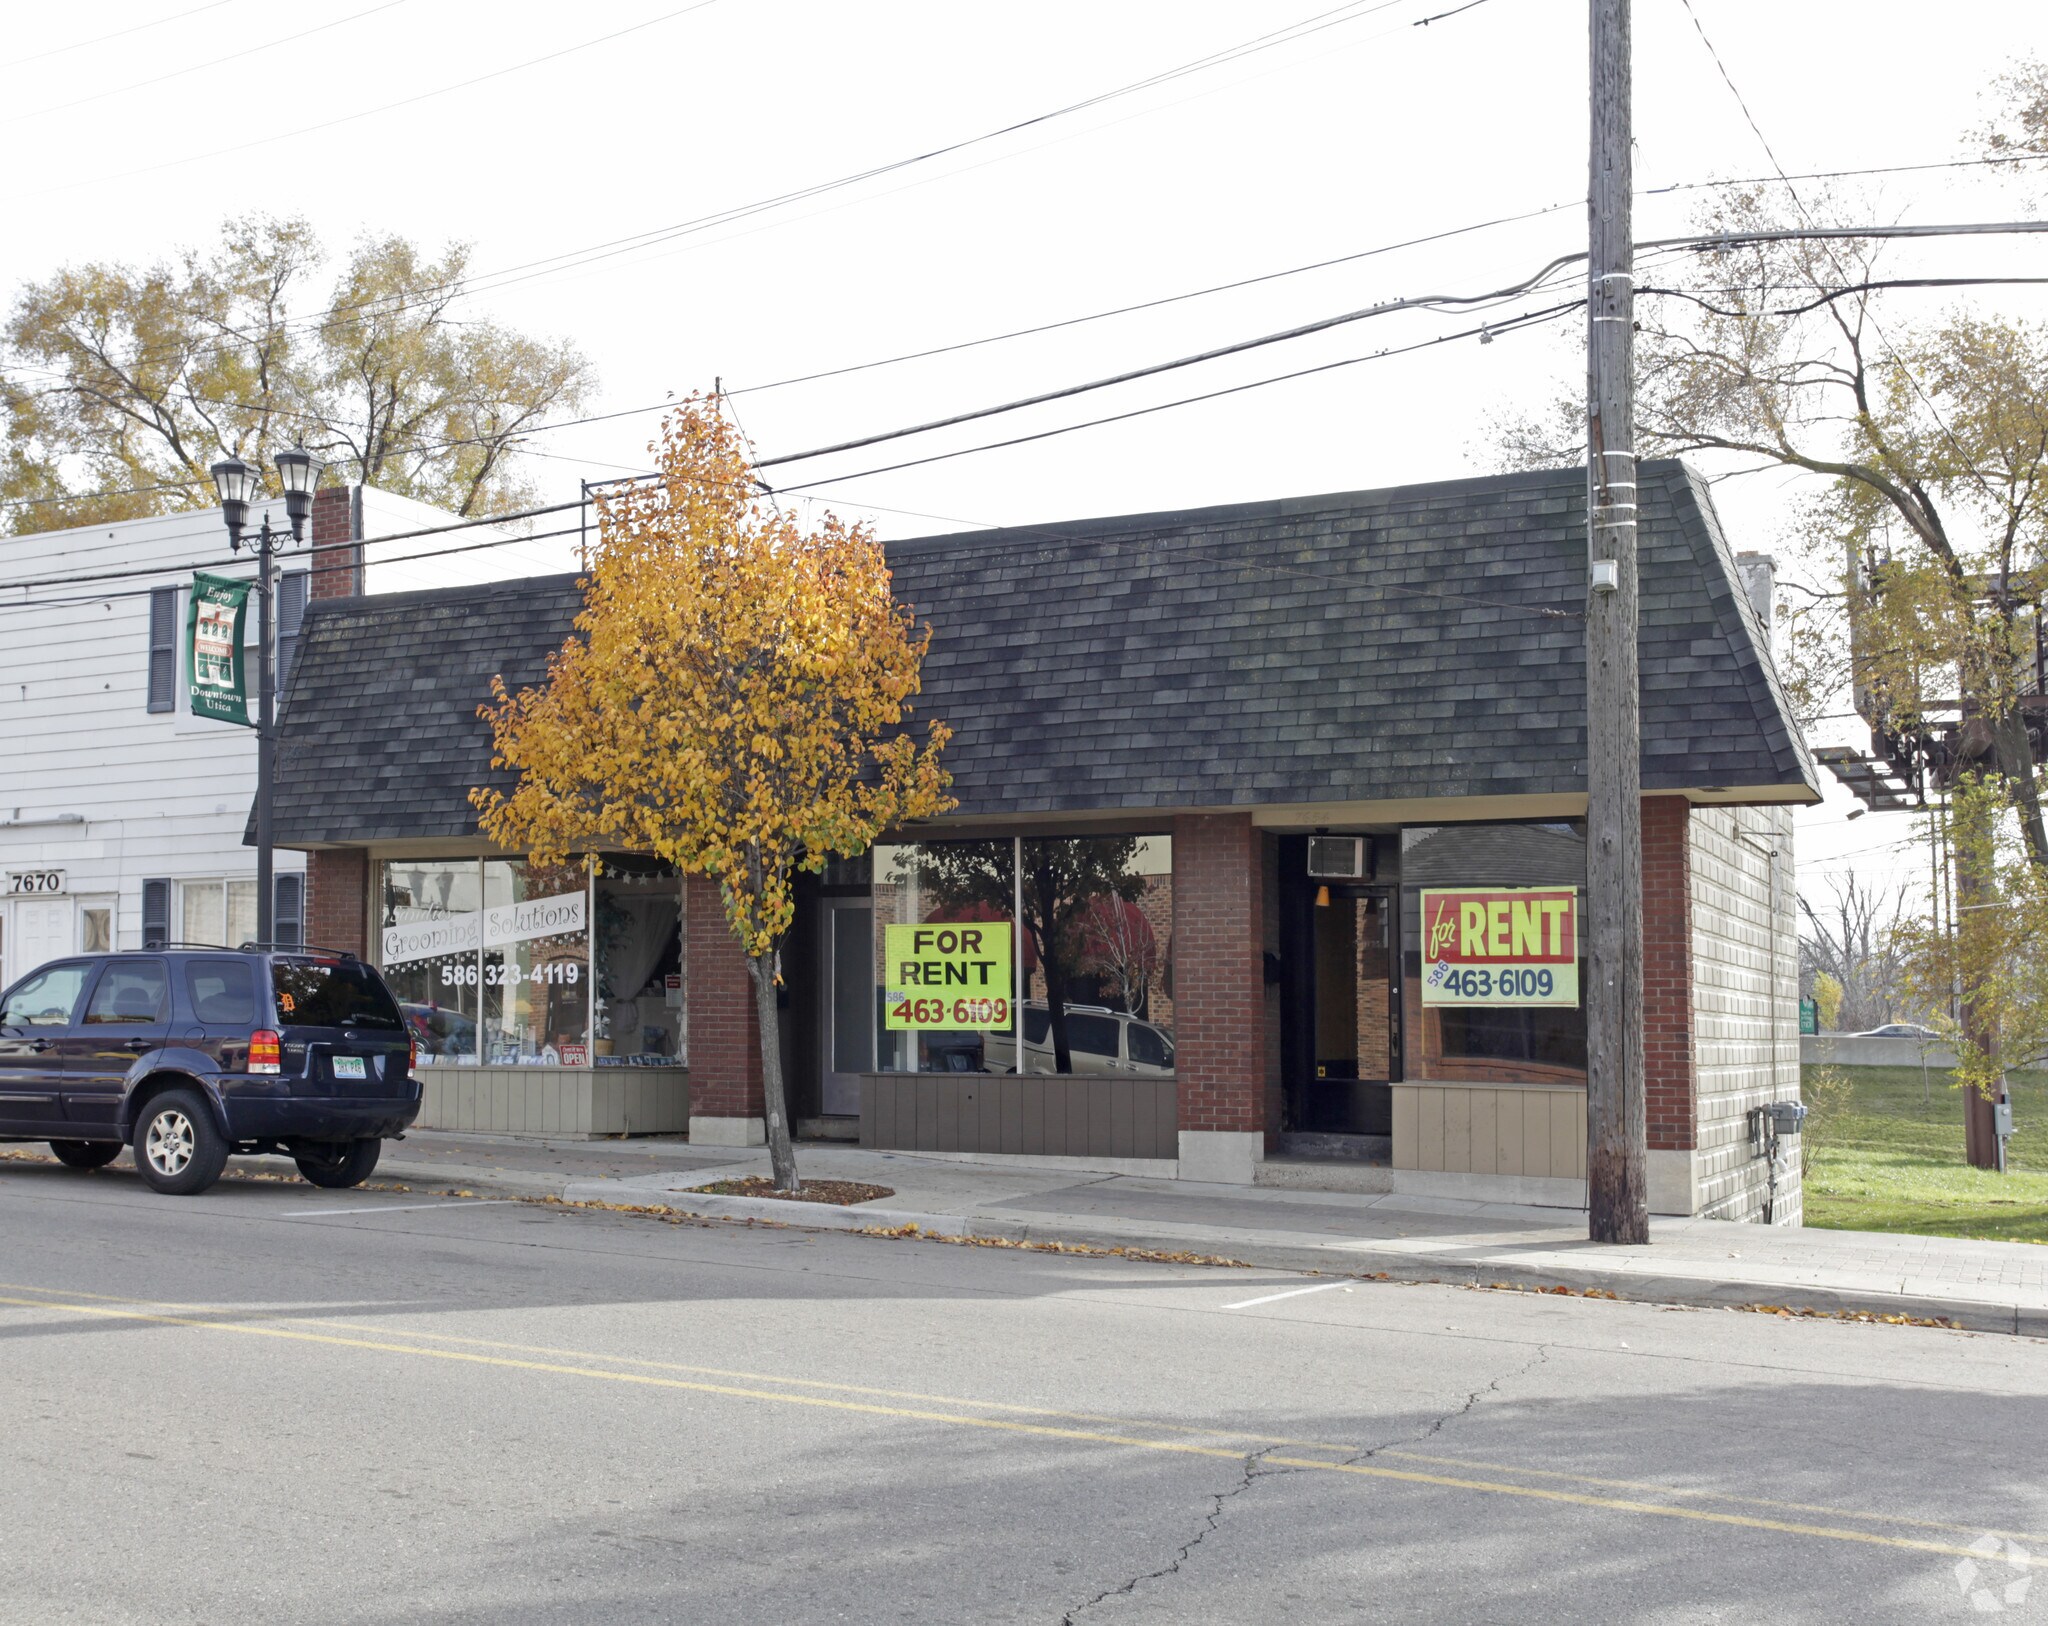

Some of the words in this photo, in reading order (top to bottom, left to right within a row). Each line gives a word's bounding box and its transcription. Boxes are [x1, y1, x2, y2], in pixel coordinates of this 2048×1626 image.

[207, 586, 233, 602] Enjoy
[200, 643, 227, 655] WELCOME
[191, 686, 241, 703] Downtown
[206, 699, 231, 712] Utica
[12, 874, 59, 892] 7670
[385, 918, 479, 961] Grooming
[490, 903, 579, 937] Solutions
[1429, 900, 1456, 959] for
[1460, 900, 1569, 957] RENT
[914, 930, 983, 954] FOR
[441, 965, 477, 985] 586
[485, 963, 579, 985] 323-4119
[900, 961, 996, 985] RENT
[1427, 961, 1449, 987] 586
[1443, 969, 1553, 997] 463-6109
[887, 992, 905, 1002] 586
[892, 998, 1008, 1023] 463-6109
[563, 1053, 585, 1065] OPEN
